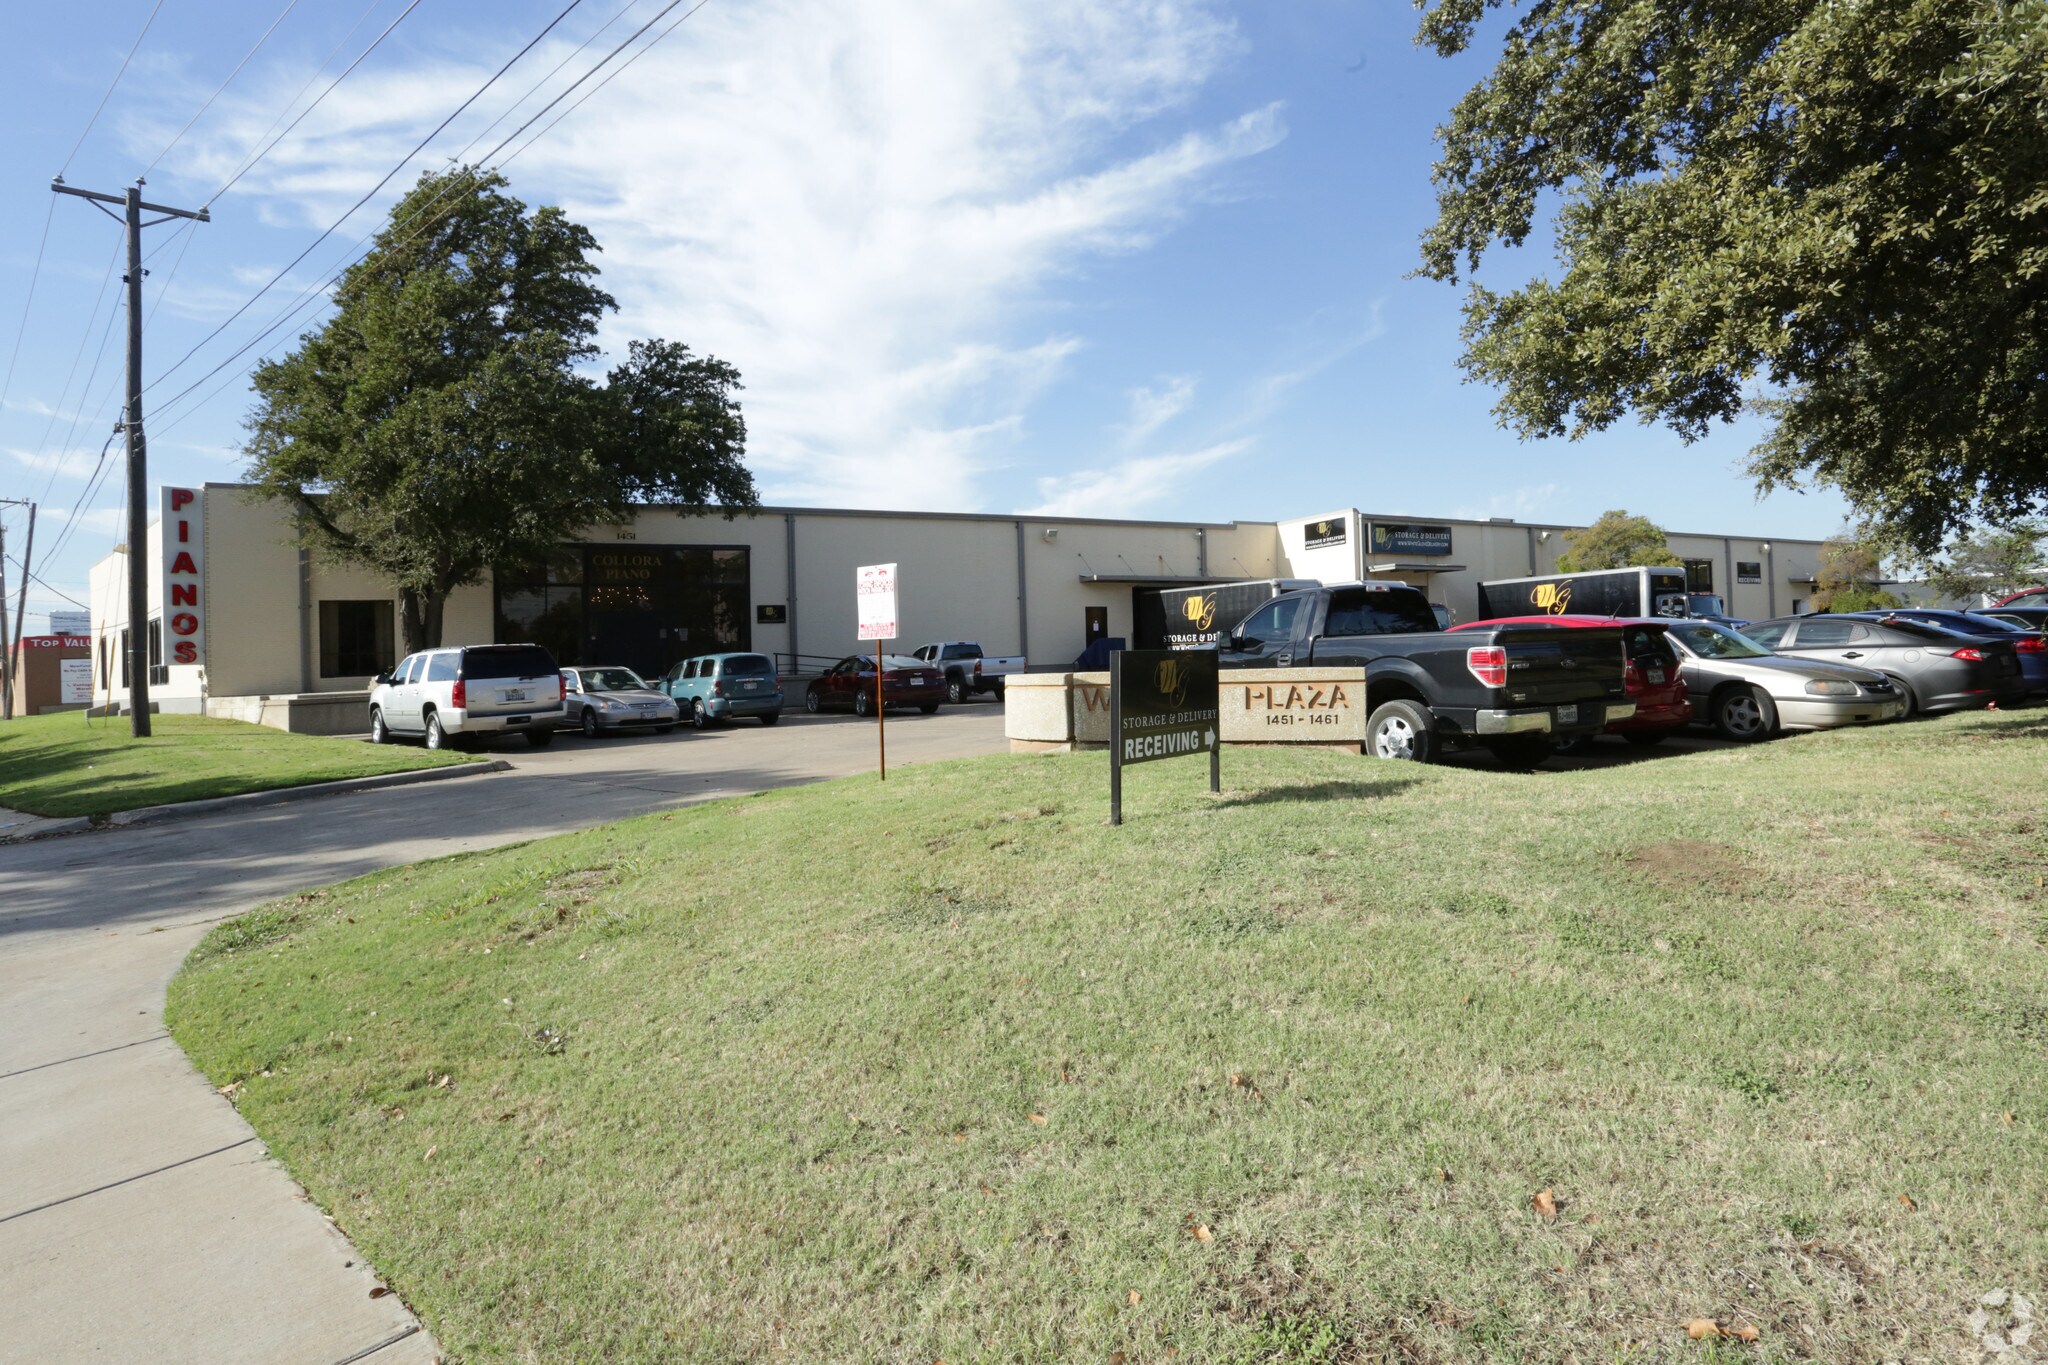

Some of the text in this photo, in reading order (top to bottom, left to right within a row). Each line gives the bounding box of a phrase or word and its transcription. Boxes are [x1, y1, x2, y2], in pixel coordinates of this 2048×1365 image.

[617, 532, 636, 540] 1451
[1394, 531, 1419, 539] STORAGE
[1425, 532, 1450, 540] DELIVERY
[592, 555, 662, 567] COLLORA
[171, 489, 198, 664] PIANOS
[606, 569, 650, 579] PIANO
[31, 639, 59, 647] TOP
[1163, 634, 1198, 643] STORAGE
[1198, 633, 1206, 642] &
[1245, 684, 1349, 710] PLAZA
[1123, 709, 1217, 729] STORAGE & DELIVERY
[1266, 715, 1294, 725] 1451
[1310, 714, 1339, 725] 1461
[1124, 730, 1199, 760] RECEIVING
